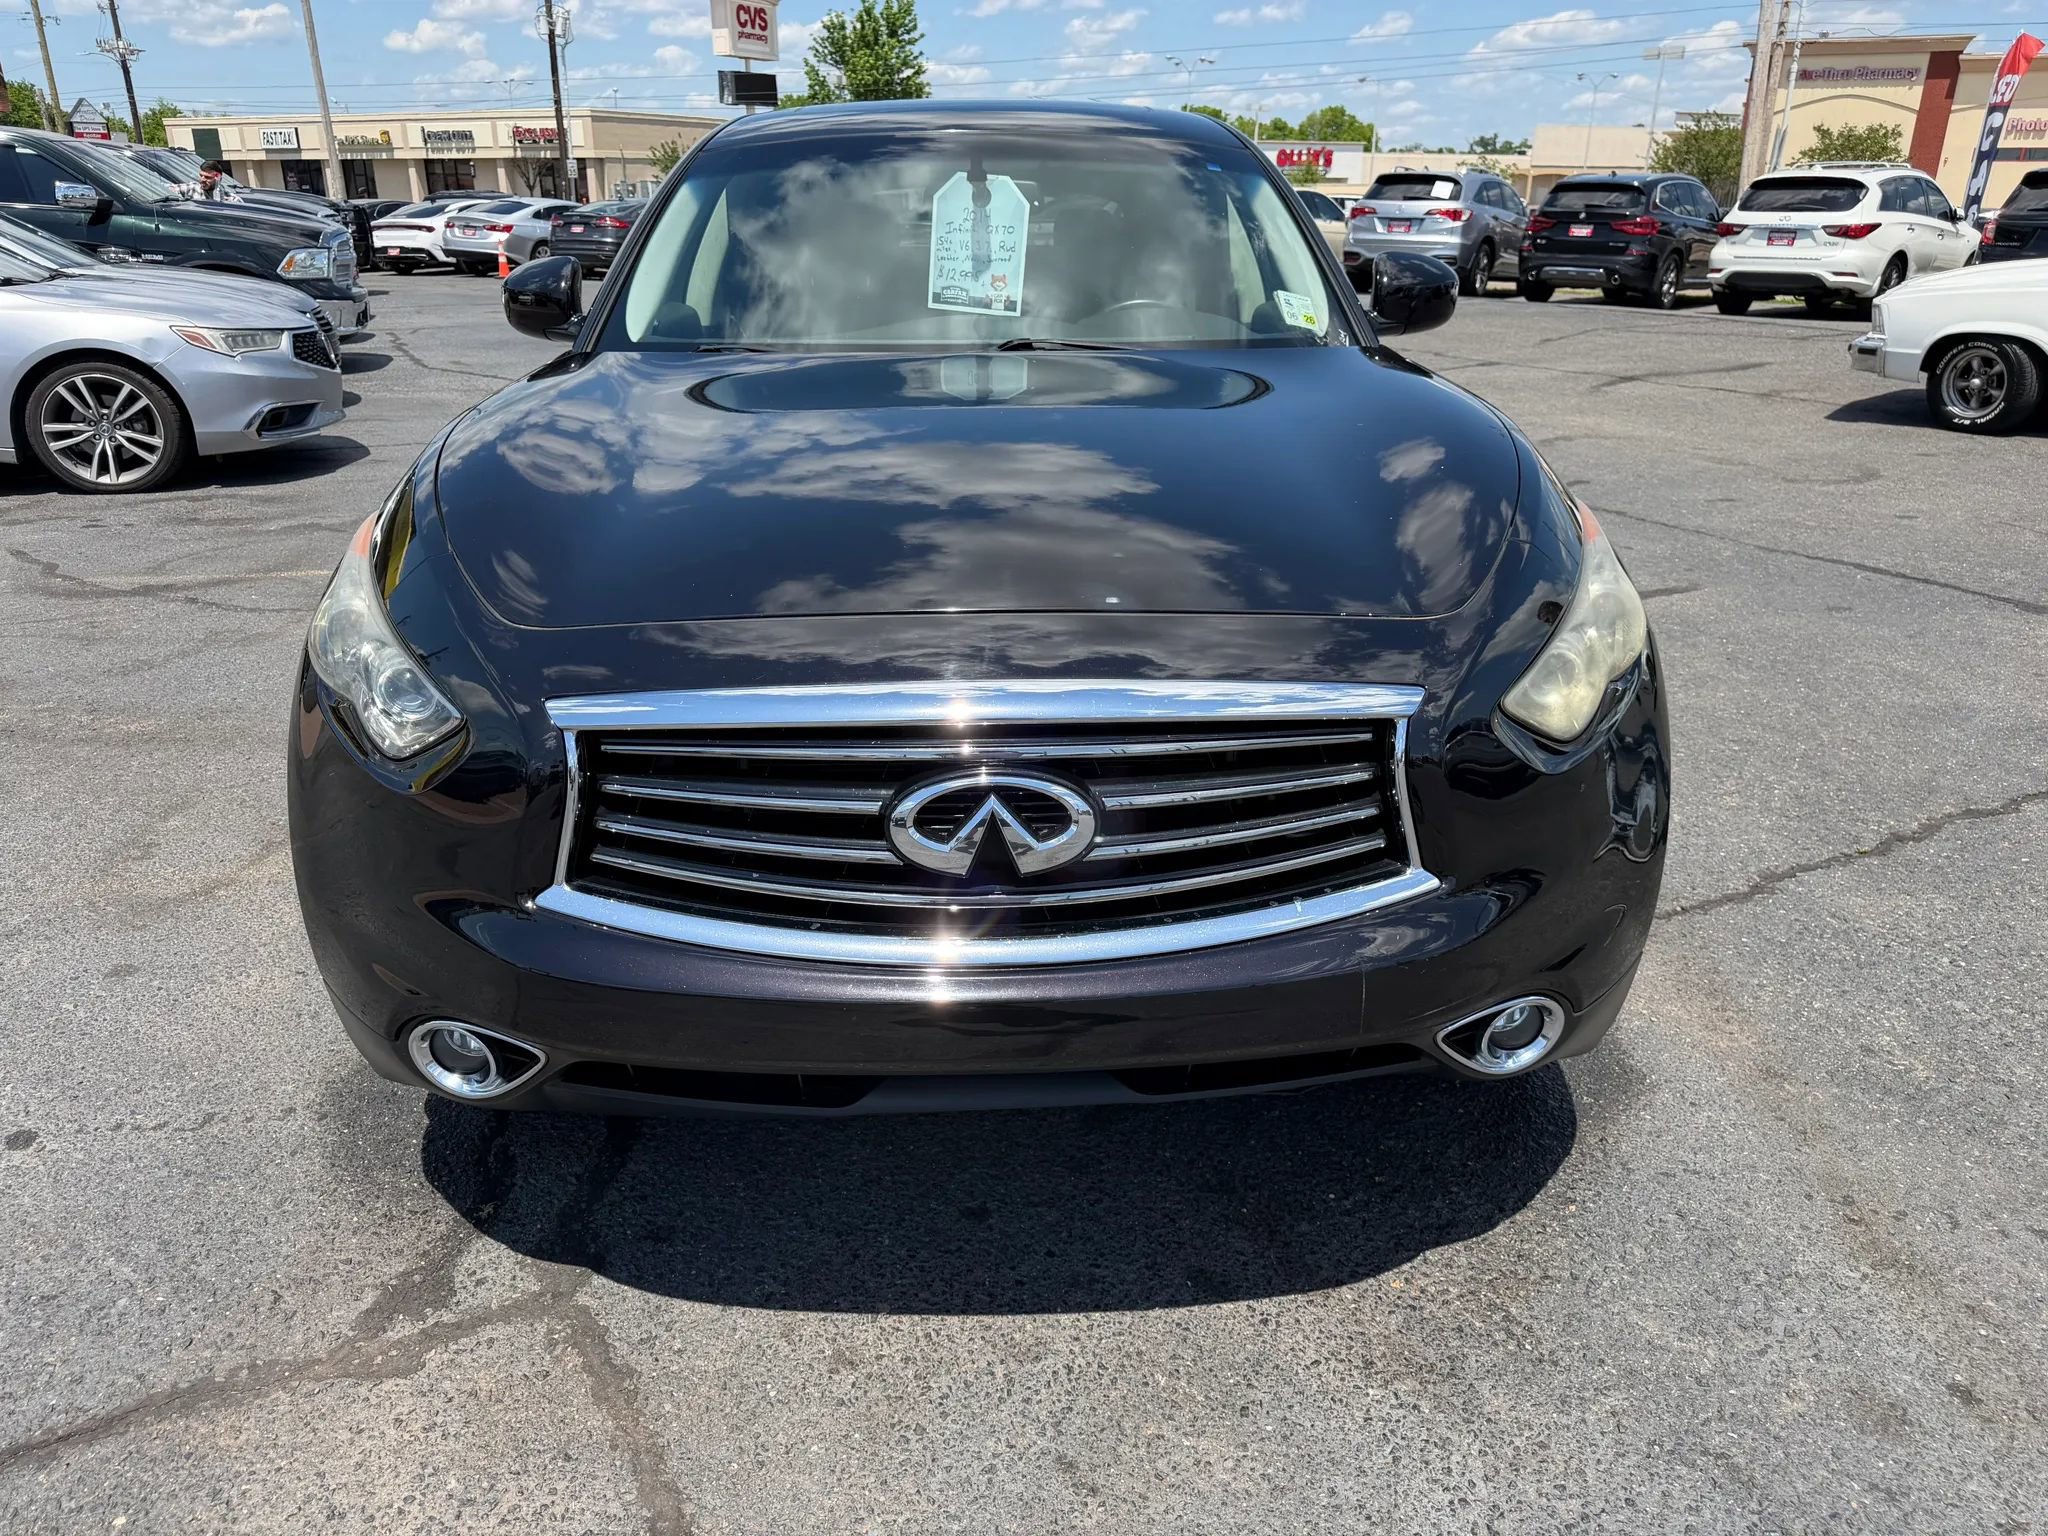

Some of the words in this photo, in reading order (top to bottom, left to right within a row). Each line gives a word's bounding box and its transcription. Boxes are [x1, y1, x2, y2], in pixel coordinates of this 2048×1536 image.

[736, 4, 768, 31] CVS
[737, 31, 768, 44] pharmacy
[1796, 67, 1851, 80] rive-Thru
[1854, 66, 1919, 81] Pharmacy
[2006, 117, 2048, 131] Photo
[263, 131, 277, 145] FAST
[1936, 344, 1965, 374] COOPER
[1968, 342, 1998, 352] COBRA
[1974, 401, 2005, 424] RADIAL
